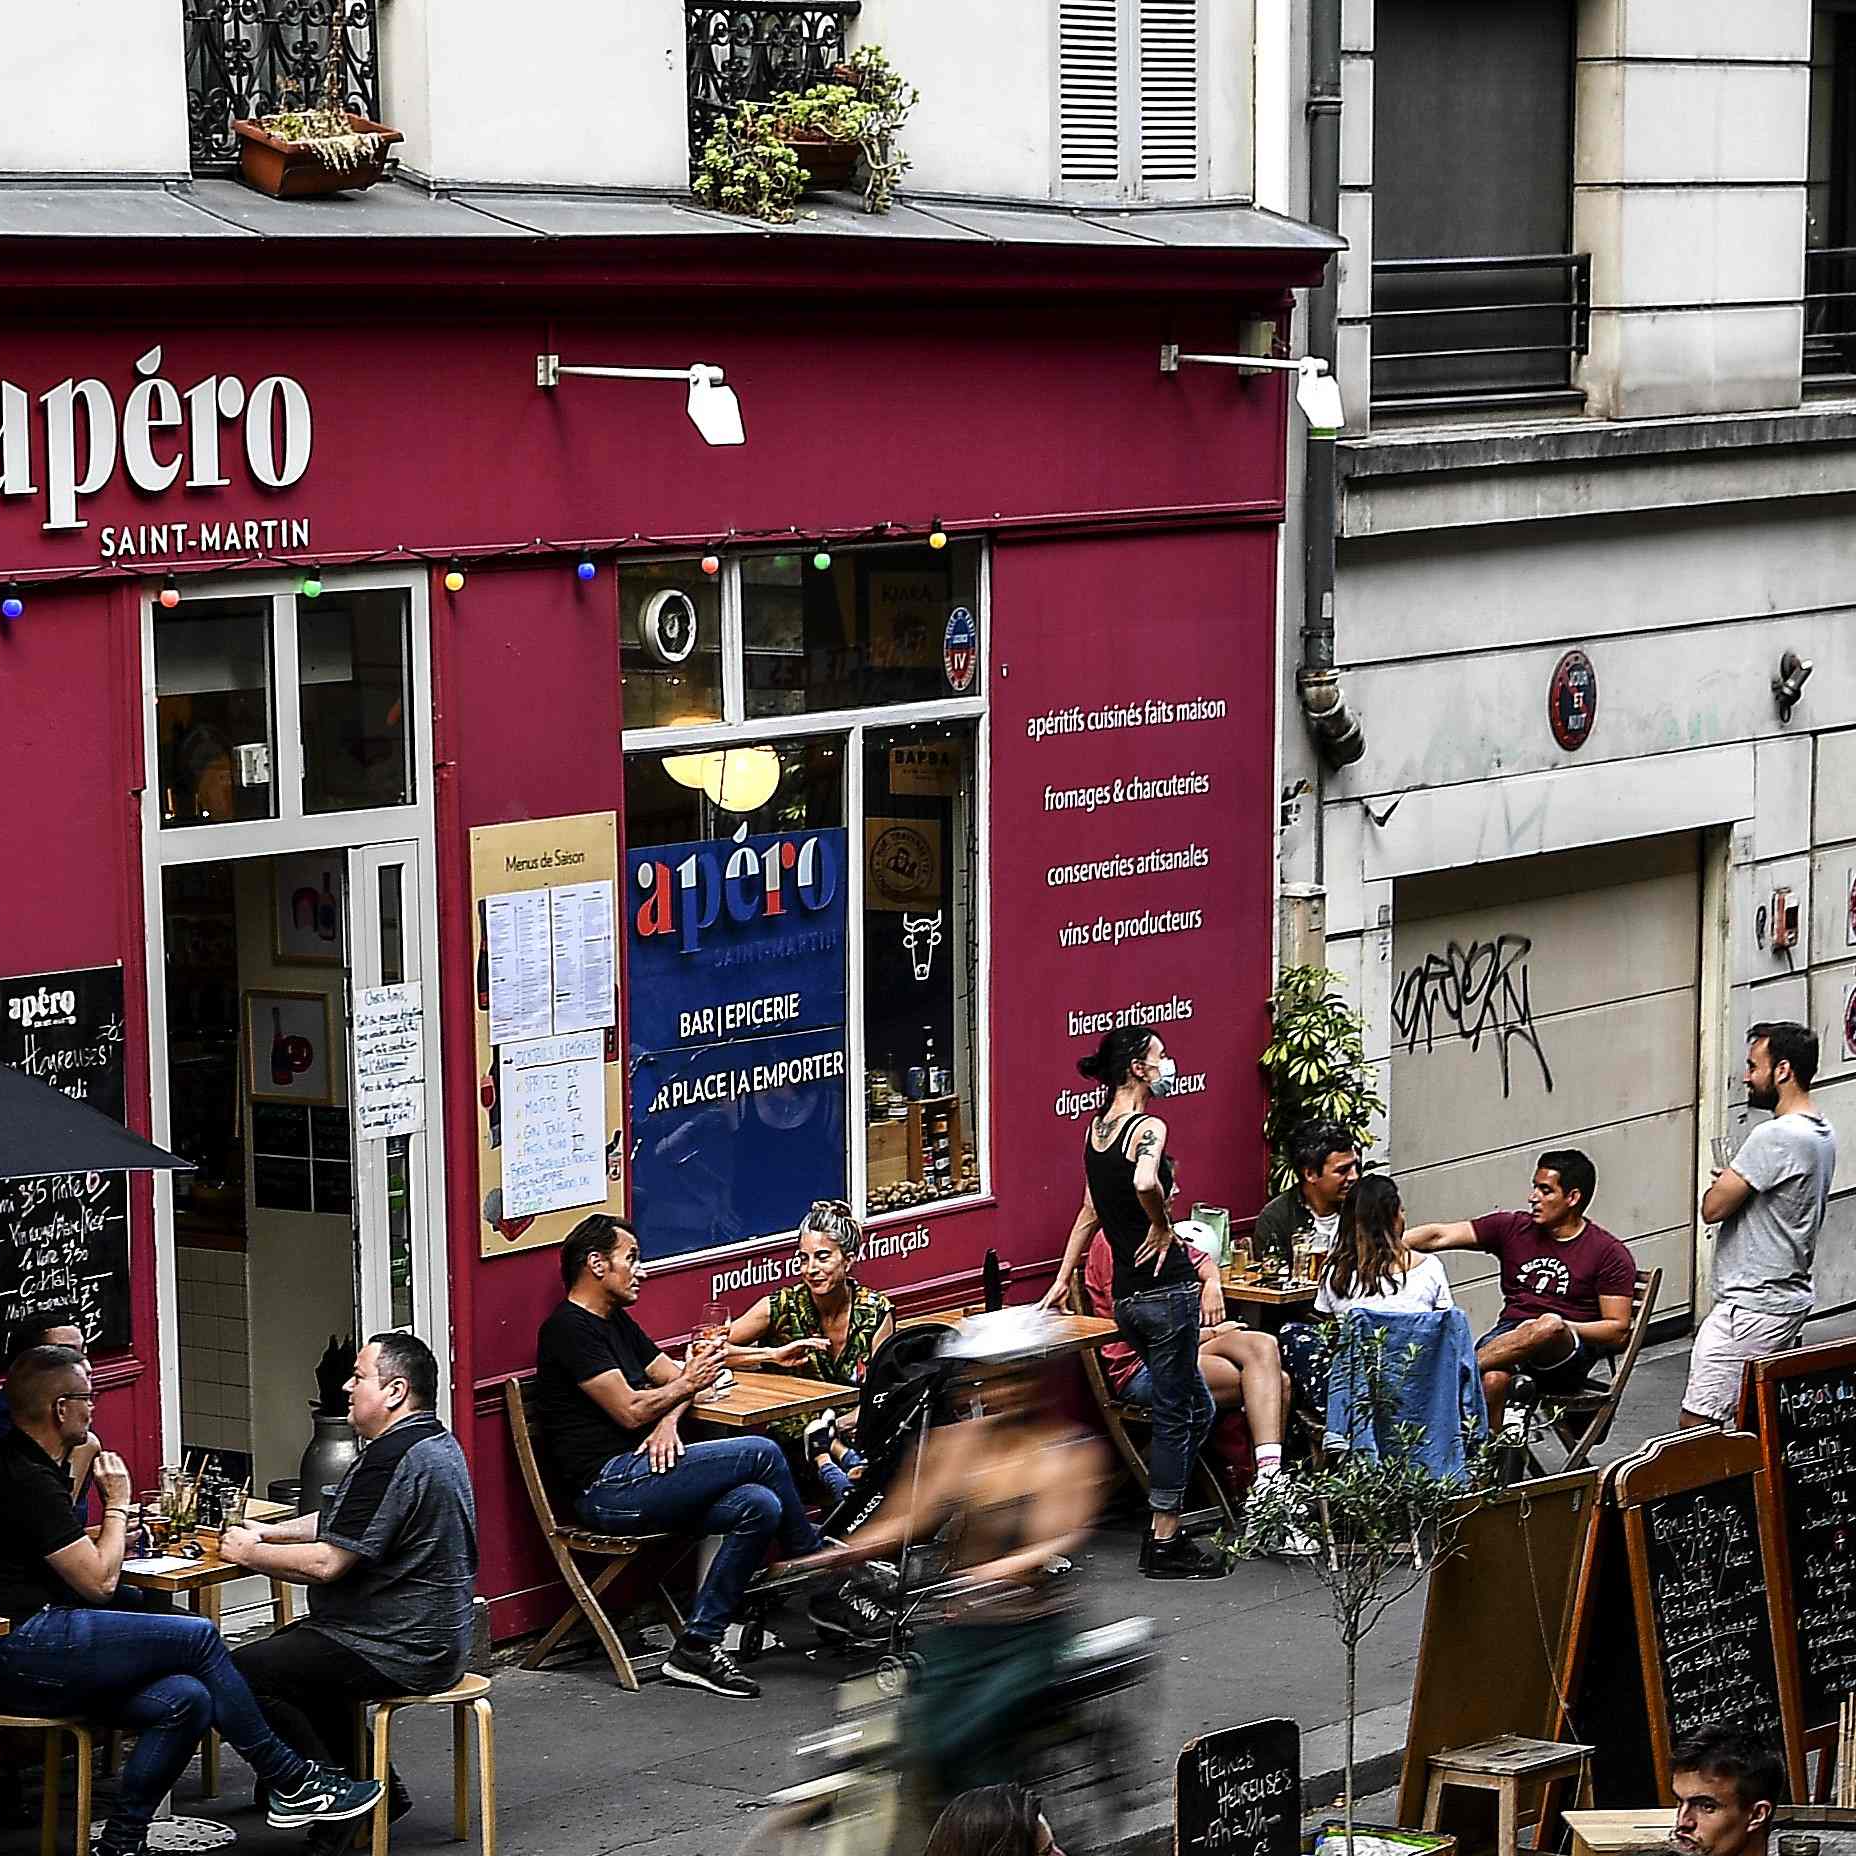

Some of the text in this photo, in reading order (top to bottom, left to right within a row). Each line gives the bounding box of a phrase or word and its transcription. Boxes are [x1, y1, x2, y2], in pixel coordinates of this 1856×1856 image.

[101, 518, 310, 557] SAINT-MARTIN
[1027, 697, 1226, 742] apéritifs cuisinés faits maison
[1045, 771, 1210, 812] fromages & charcuteries
[506, 848, 585, 872] Menus de Saison
[1048, 844, 1209, 887] conserveries artisanales
[636, 821, 836, 954] apéro
[1059, 908, 1202, 947] vins de producteurs
[9, 987, 76, 1027] apéro
[680, 993, 802, 1037] BAR EPICERIE
[1115, 995, 1193, 1027] artisanales
[672, 1072, 729, 1108] PLACE
[737, 1070, 751, 1095] A
[753, 1051, 844, 1092] EMPORTER
[712, 1256, 783, 1300] produits
[868, 1224, 929, 1260] français
